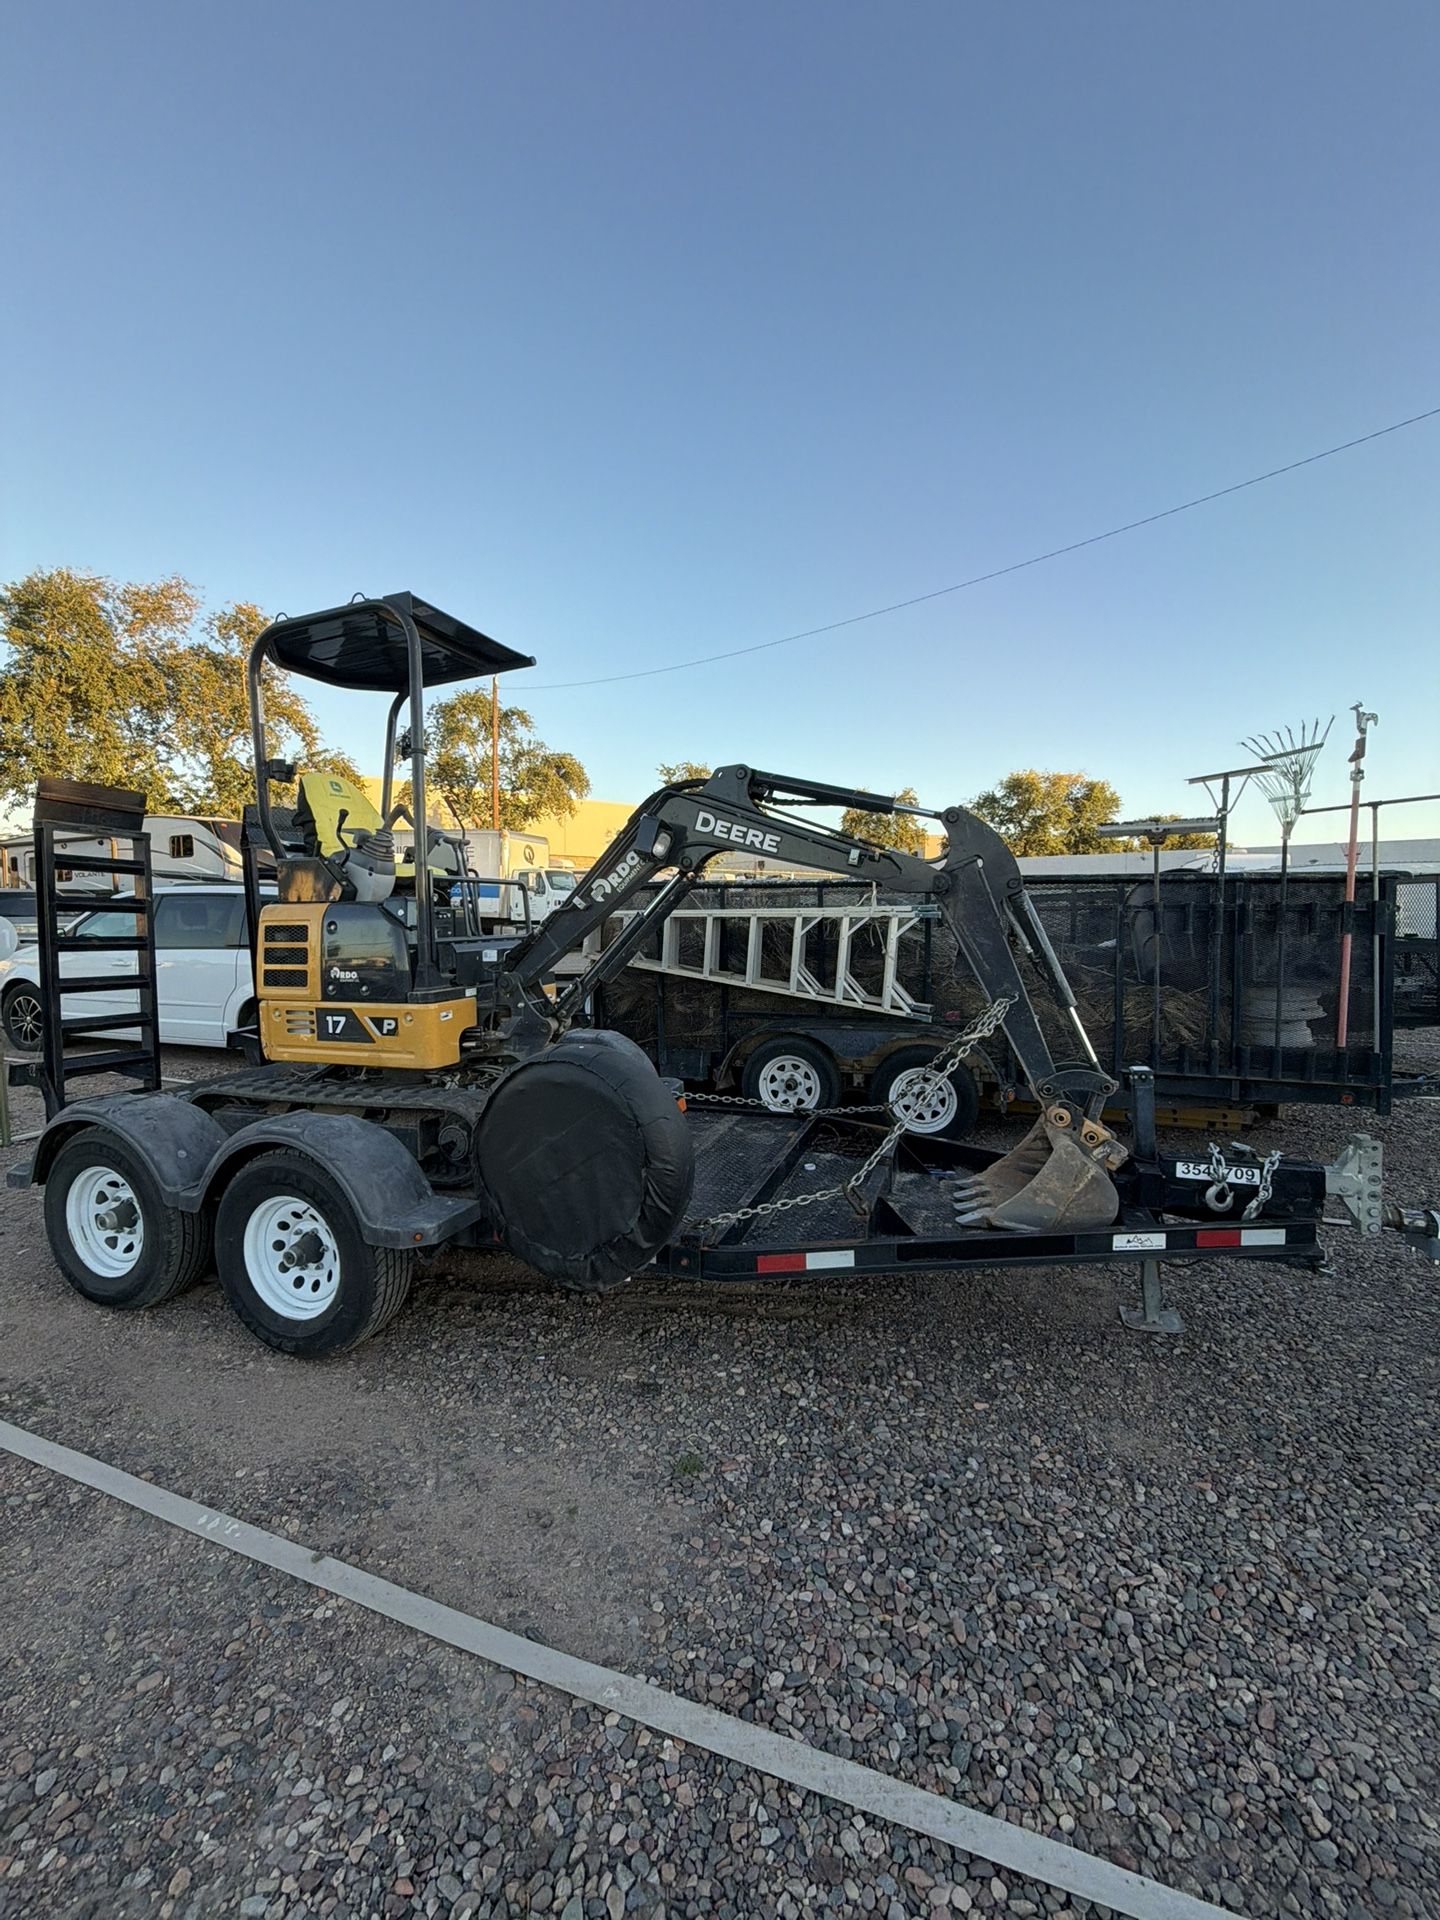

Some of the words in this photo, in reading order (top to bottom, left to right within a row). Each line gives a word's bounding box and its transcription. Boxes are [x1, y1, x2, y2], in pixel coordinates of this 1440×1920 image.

[695, 810, 781, 853] DEERE
[616, 863, 643, 893] EQUIPMENT
[326, 1016, 346, 1034] 17
[383, 1019, 396, 1034] P
